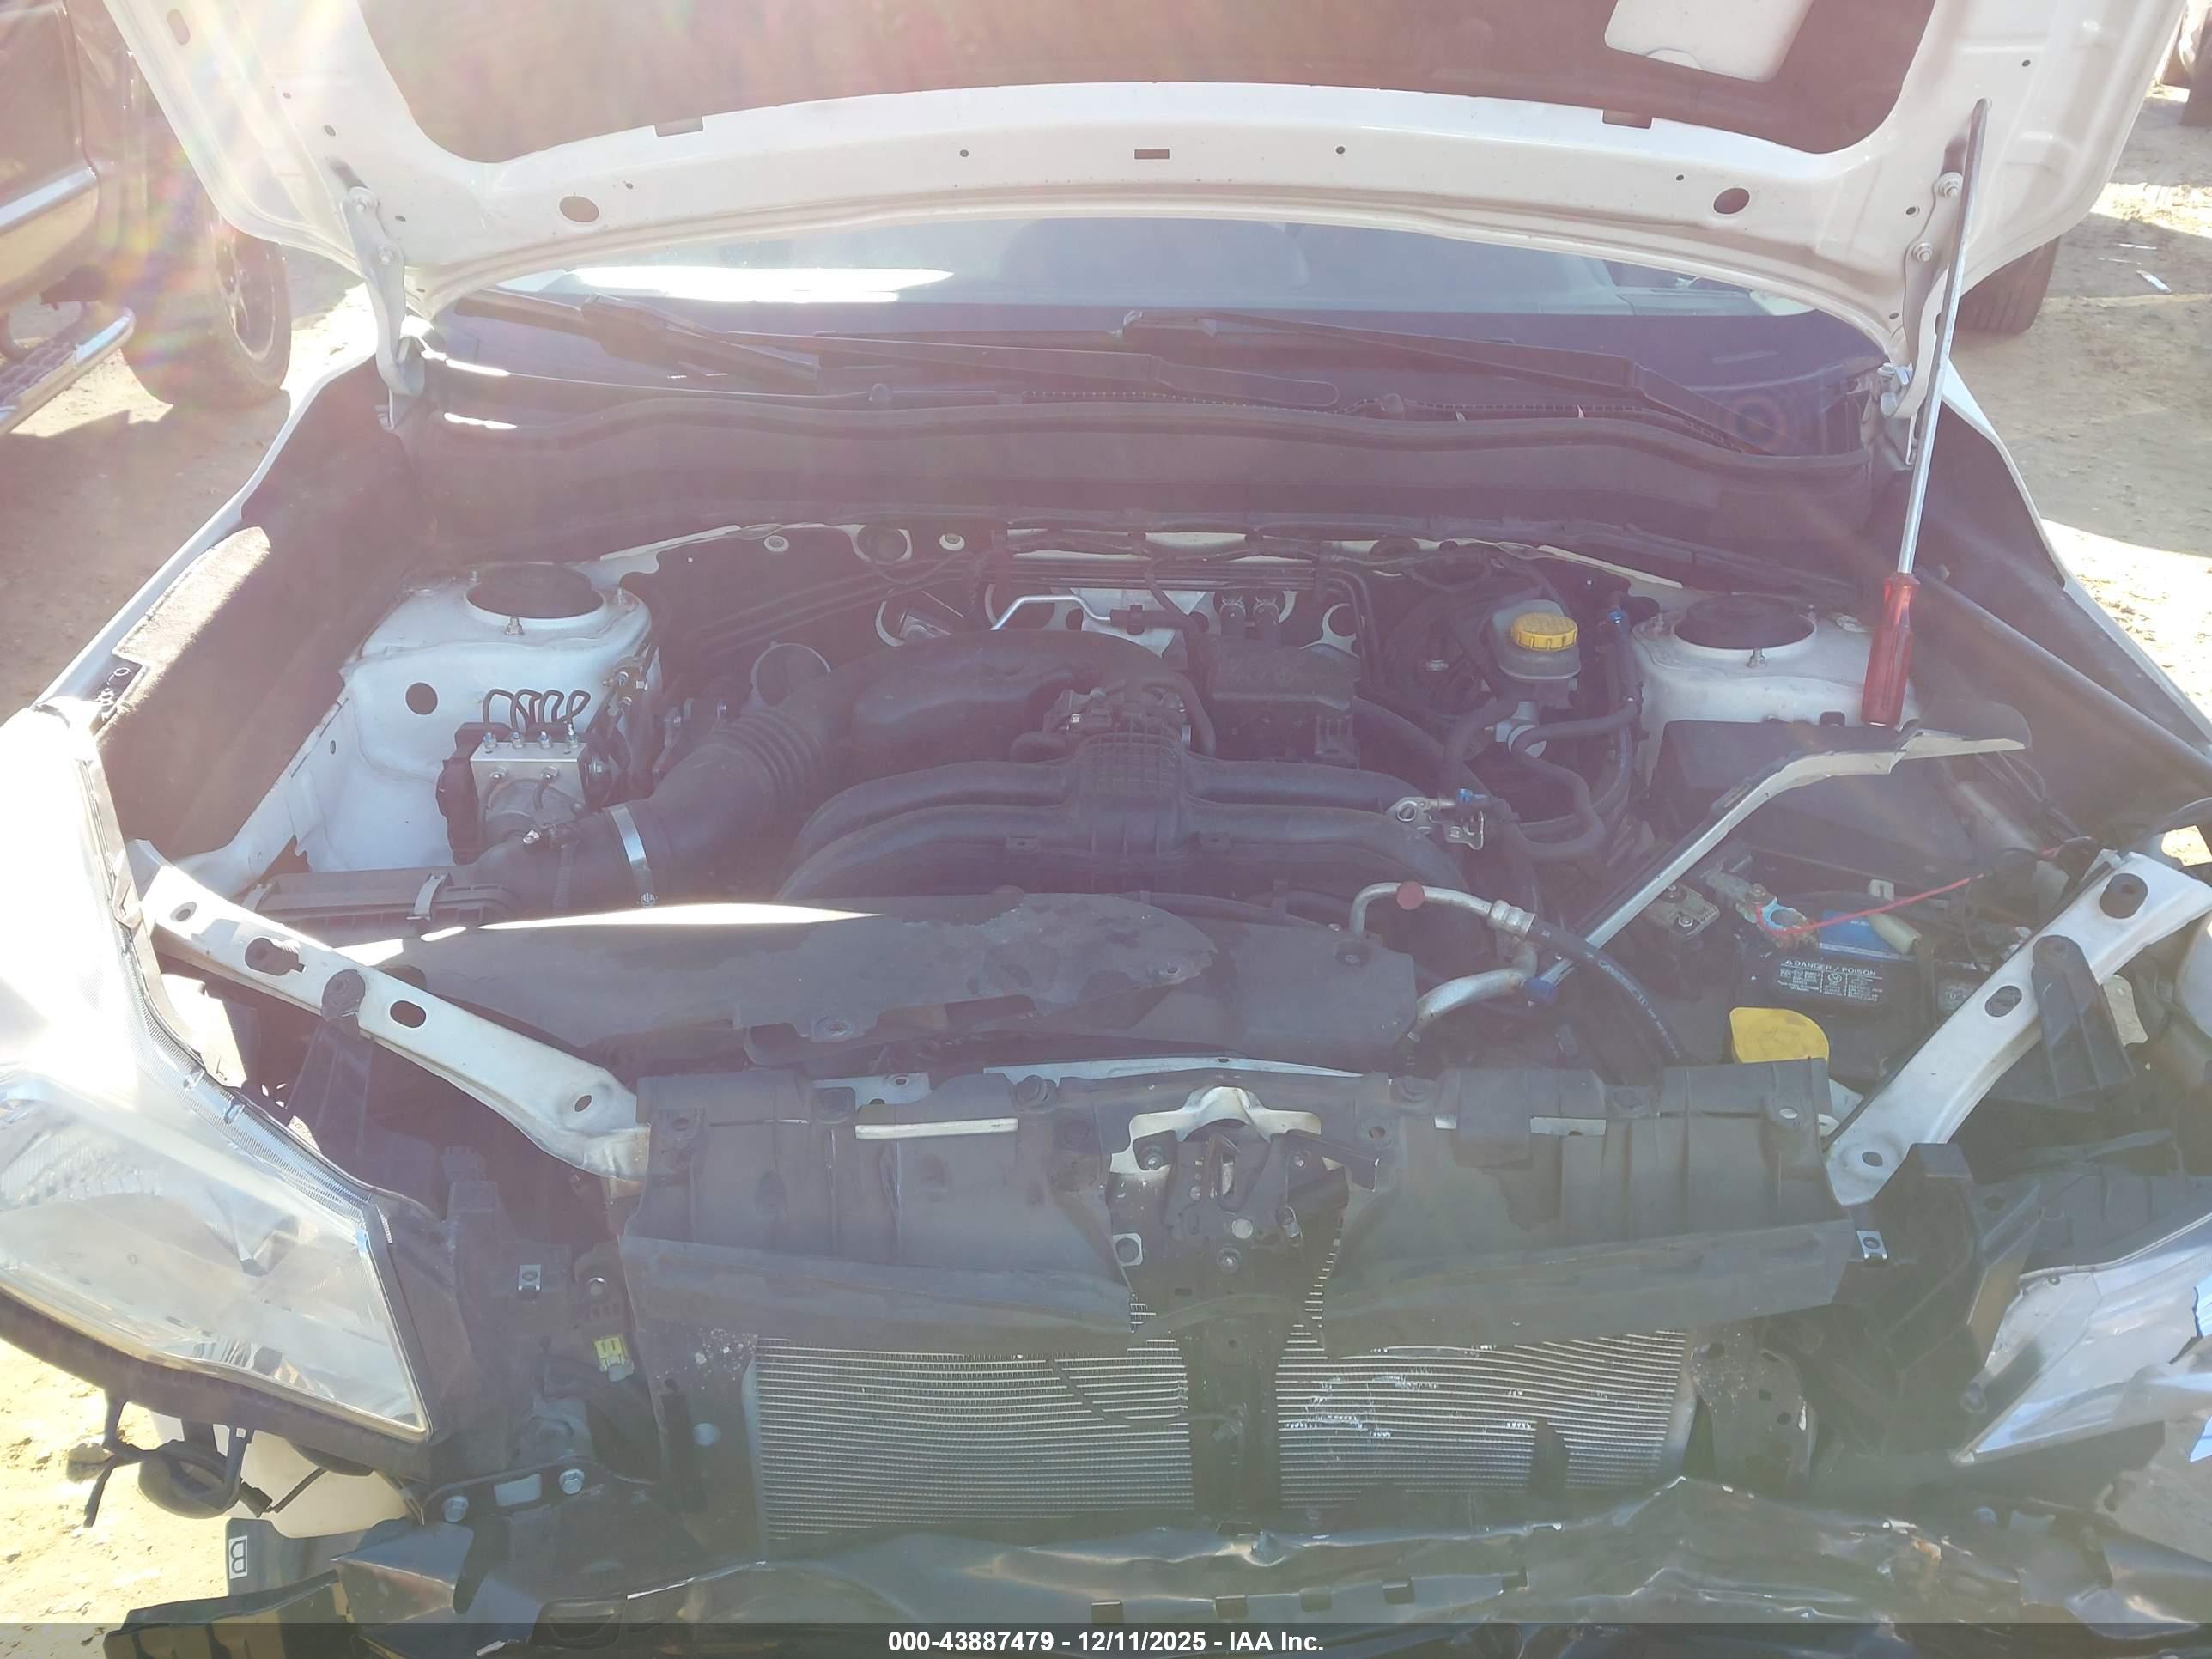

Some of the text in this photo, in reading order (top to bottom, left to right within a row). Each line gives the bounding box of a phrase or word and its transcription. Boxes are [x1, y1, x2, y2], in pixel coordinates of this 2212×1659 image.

[1794, 960, 1832, 970] DANGER
[1842, 967, 1876, 976] POISON
[230, 1538, 246, 1574] B
